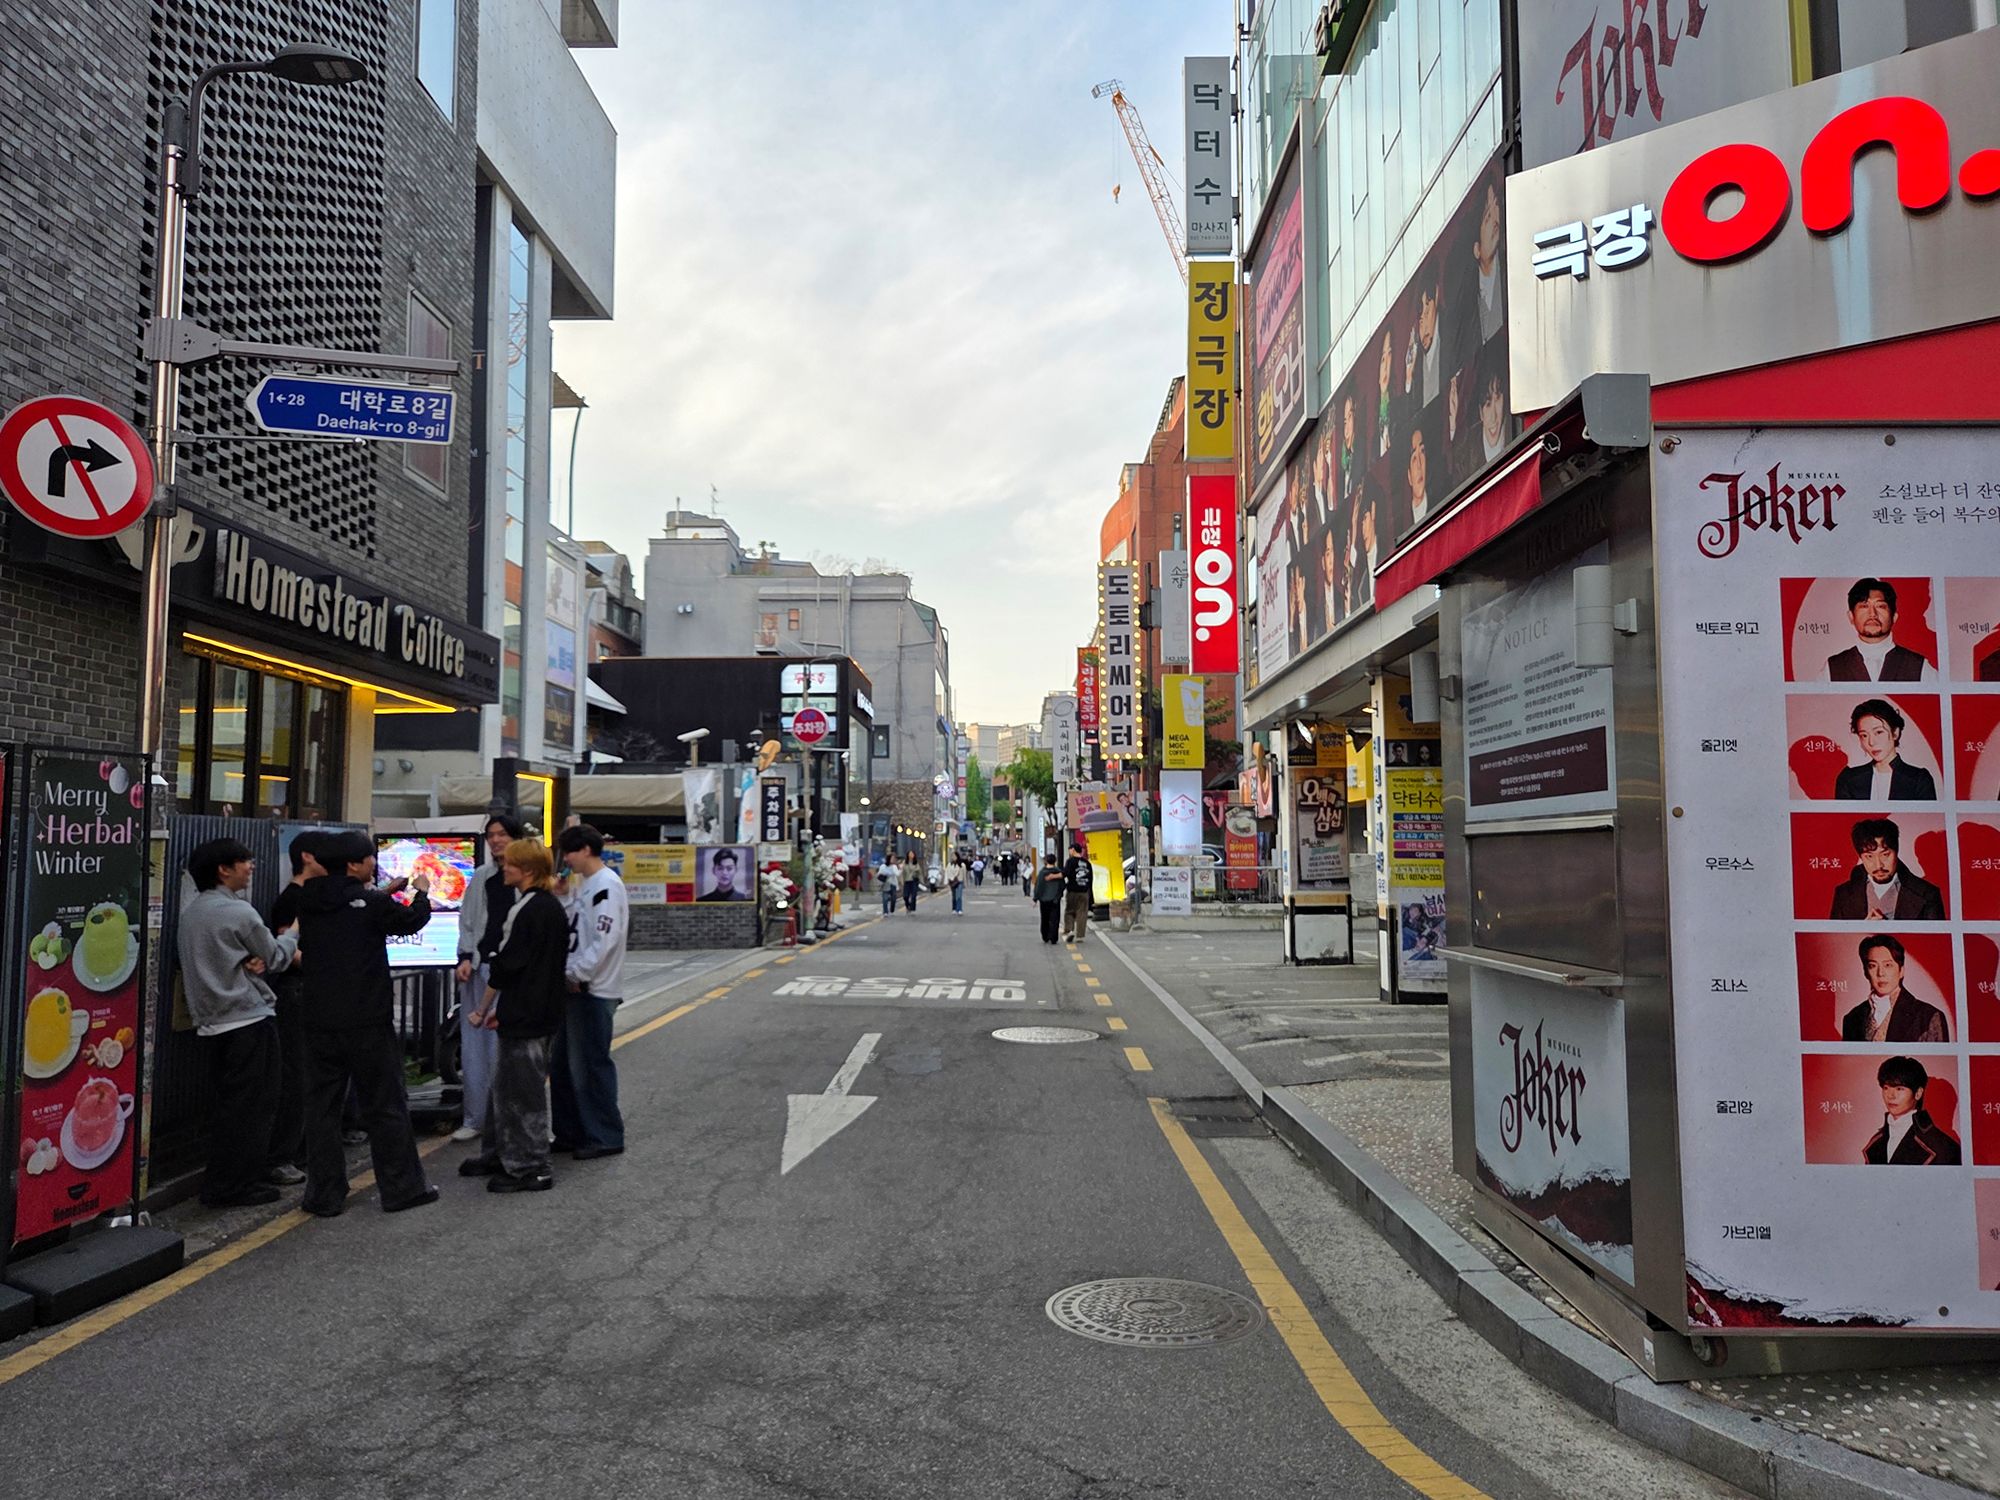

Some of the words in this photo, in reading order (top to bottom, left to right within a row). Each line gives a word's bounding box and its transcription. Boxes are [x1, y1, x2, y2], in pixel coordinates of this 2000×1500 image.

[1193, 84, 1223, 205] 닥터수
[1191, 222, 1228, 233] 마사지
[1532, 203, 1656, 281] 극장
[1194, 282, 1231, 429] 정극장
[288, 393, 305, 406] 28
[340, 390, 447, 420] 대학로8길
[317, 413, 404, 434] Daehak-ro
[407, 421, 445, 439] 8-gil
[1788, 472, 1840, 480] MUSICAL
[1879, 482, 1947, 500] 소설보다
[1953, 482, 1970, 500] 더
[1697, 461, 1847, 559] Joker
[1872, 507, 1907, 524] 펜을
[1912, 507, 1946, 524] 들어
[1201, 507, 1221, 547] 극장
[225, 528, 388, 653] Homestead
[400, 604, 466, 678] Coffee
[1194, 548, 1233, 642] on.
[1503, 617, 1549, 654] NOTICE
[1696, 622, 1732, 635] 빅토르
[1735, 622, 1760, 635] 위고
[1959, 622, 1990, 634] 백인태
[1108, 574, 1133, 746] 도토리씨어터
[795, 722, 825, 735] 주차장
[1169, 734, 1190, 742] MEGA
[44, 781, 109, 816] Merry
[767, 786, 780, 828] 주차장
[47, 814, 132, 844] Herbal
[36, 851, 104, 875] Winter
[1705, 857, 1754, 871] 우르수스
[1808, 857, 1842, 869] 김주호
[1711, 978, 1748, 993] 조나스
[1816, 980, 1848, 993] 조성민
[1547, 1038, 1582, 1058] MUSICAL
[1499, 1017, 1587, 1157] Joker
[1721, 1225, 1771, 1239] 가브리엘
